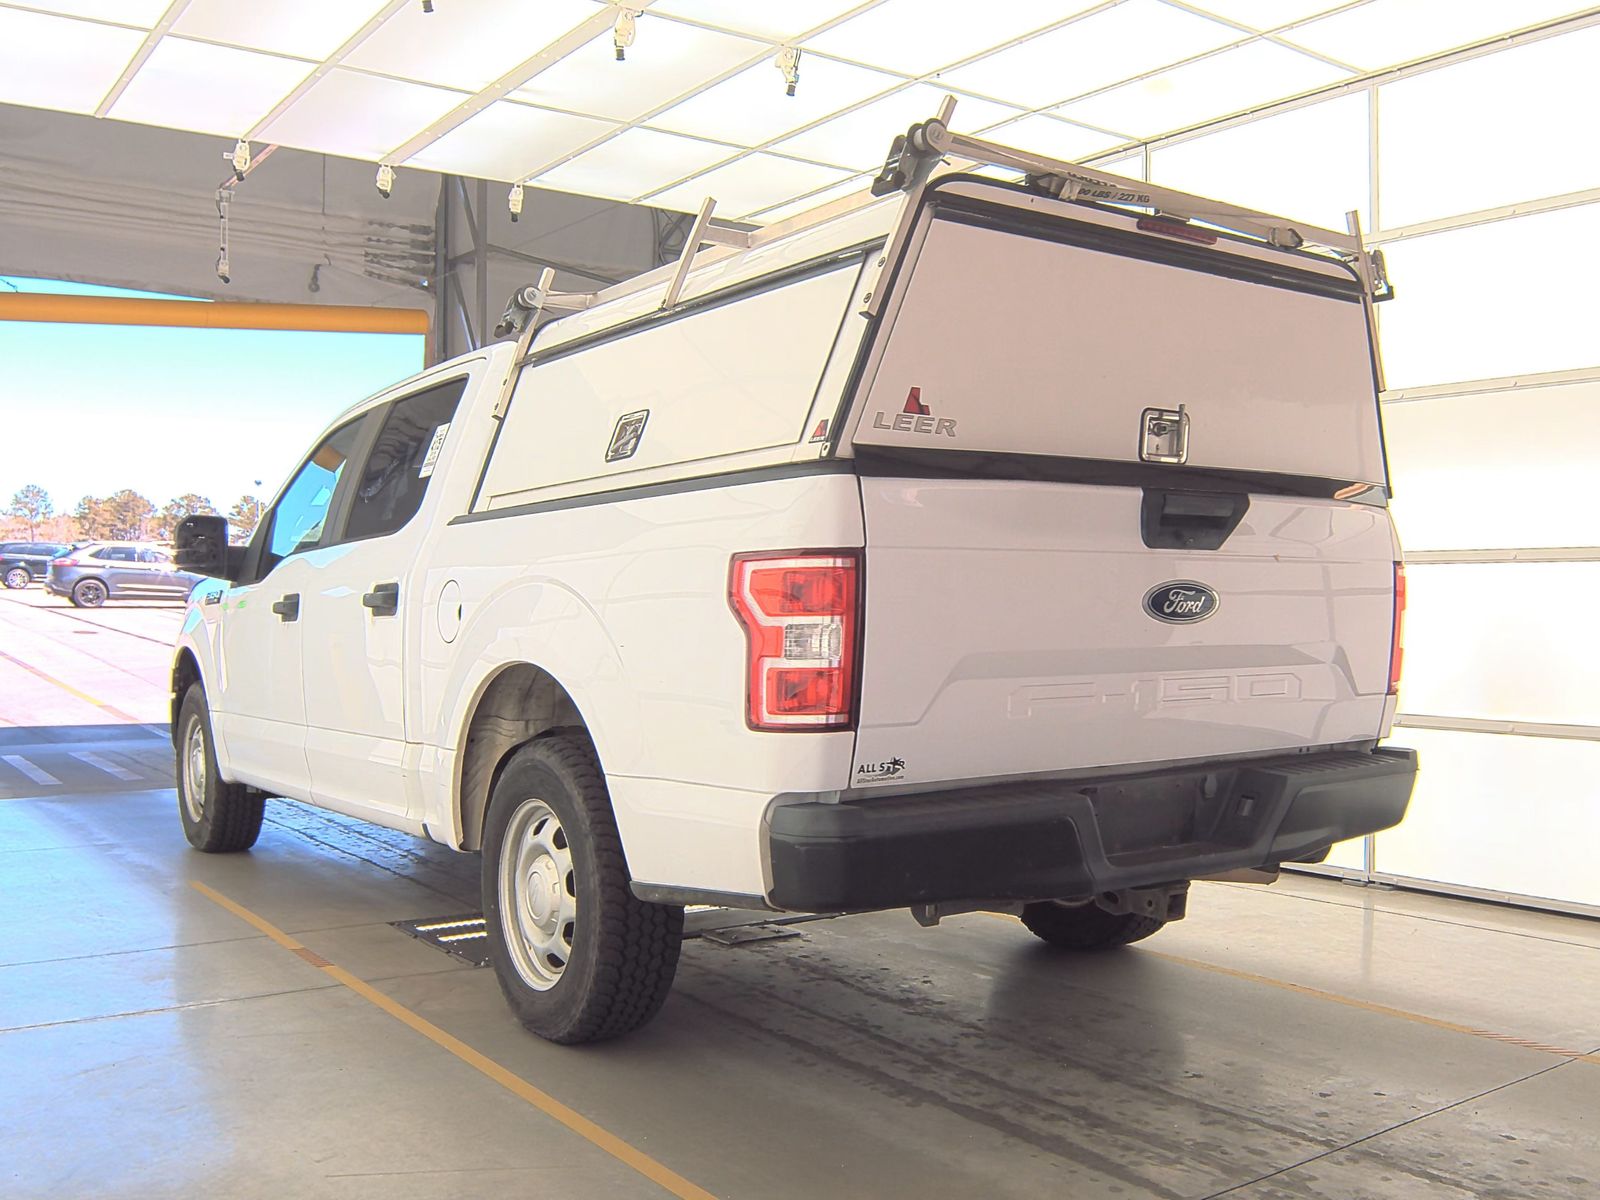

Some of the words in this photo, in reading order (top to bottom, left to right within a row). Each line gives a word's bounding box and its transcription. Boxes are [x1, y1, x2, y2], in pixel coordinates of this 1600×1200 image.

[1091, 189, 1112, 199] LBS
[1119, 192, 1135, 202] 227
[1136, 193, 1150, 203] KG
[873, 411, 957, 437] LEER
[1163, 589, 1206, 614] Ford
[857, 763, 877, 774] ALL
